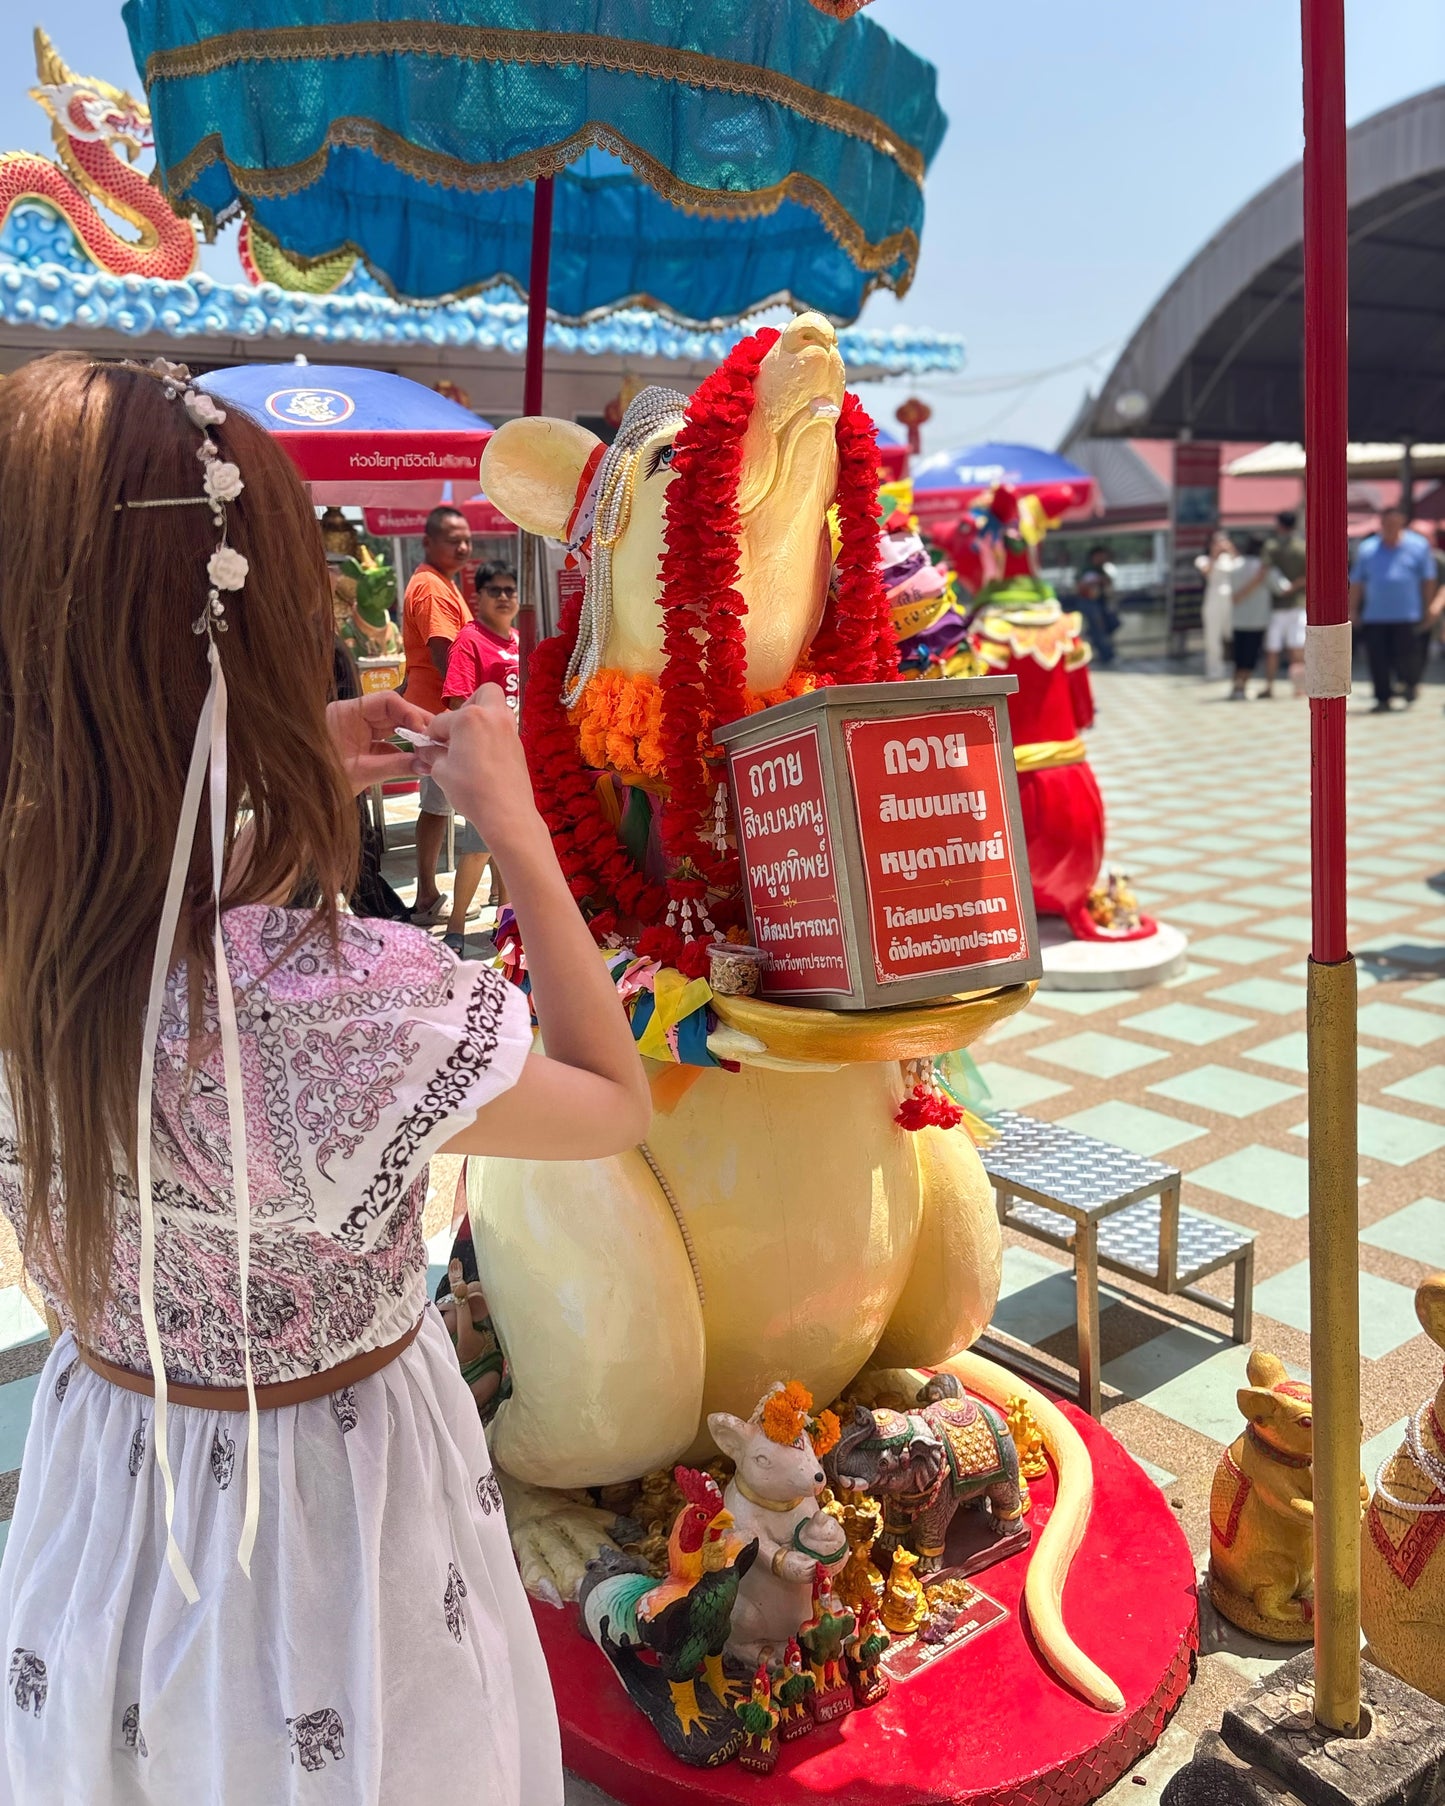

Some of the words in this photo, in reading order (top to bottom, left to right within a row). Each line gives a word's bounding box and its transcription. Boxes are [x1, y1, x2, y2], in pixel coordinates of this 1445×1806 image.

[748, 750, 803, 797] ถวาย
[883, 733, 968, 775] ถวาย
[743, 798, 824, 839] สินบนหนู
[879, 790, 987, 823] สินบนหนู
[750, 838, 830, 898] หนูหูทิพย์
[880, 831, 1005, 881] หนูตาทิพย์
[755, 916, 839, 942] ได้สมปรารถนา
[883, 897, 1007, 929] ได้สมปรารถนา
[888, 928, 1018, 961] ดั่งใจหวังทุกประการ
